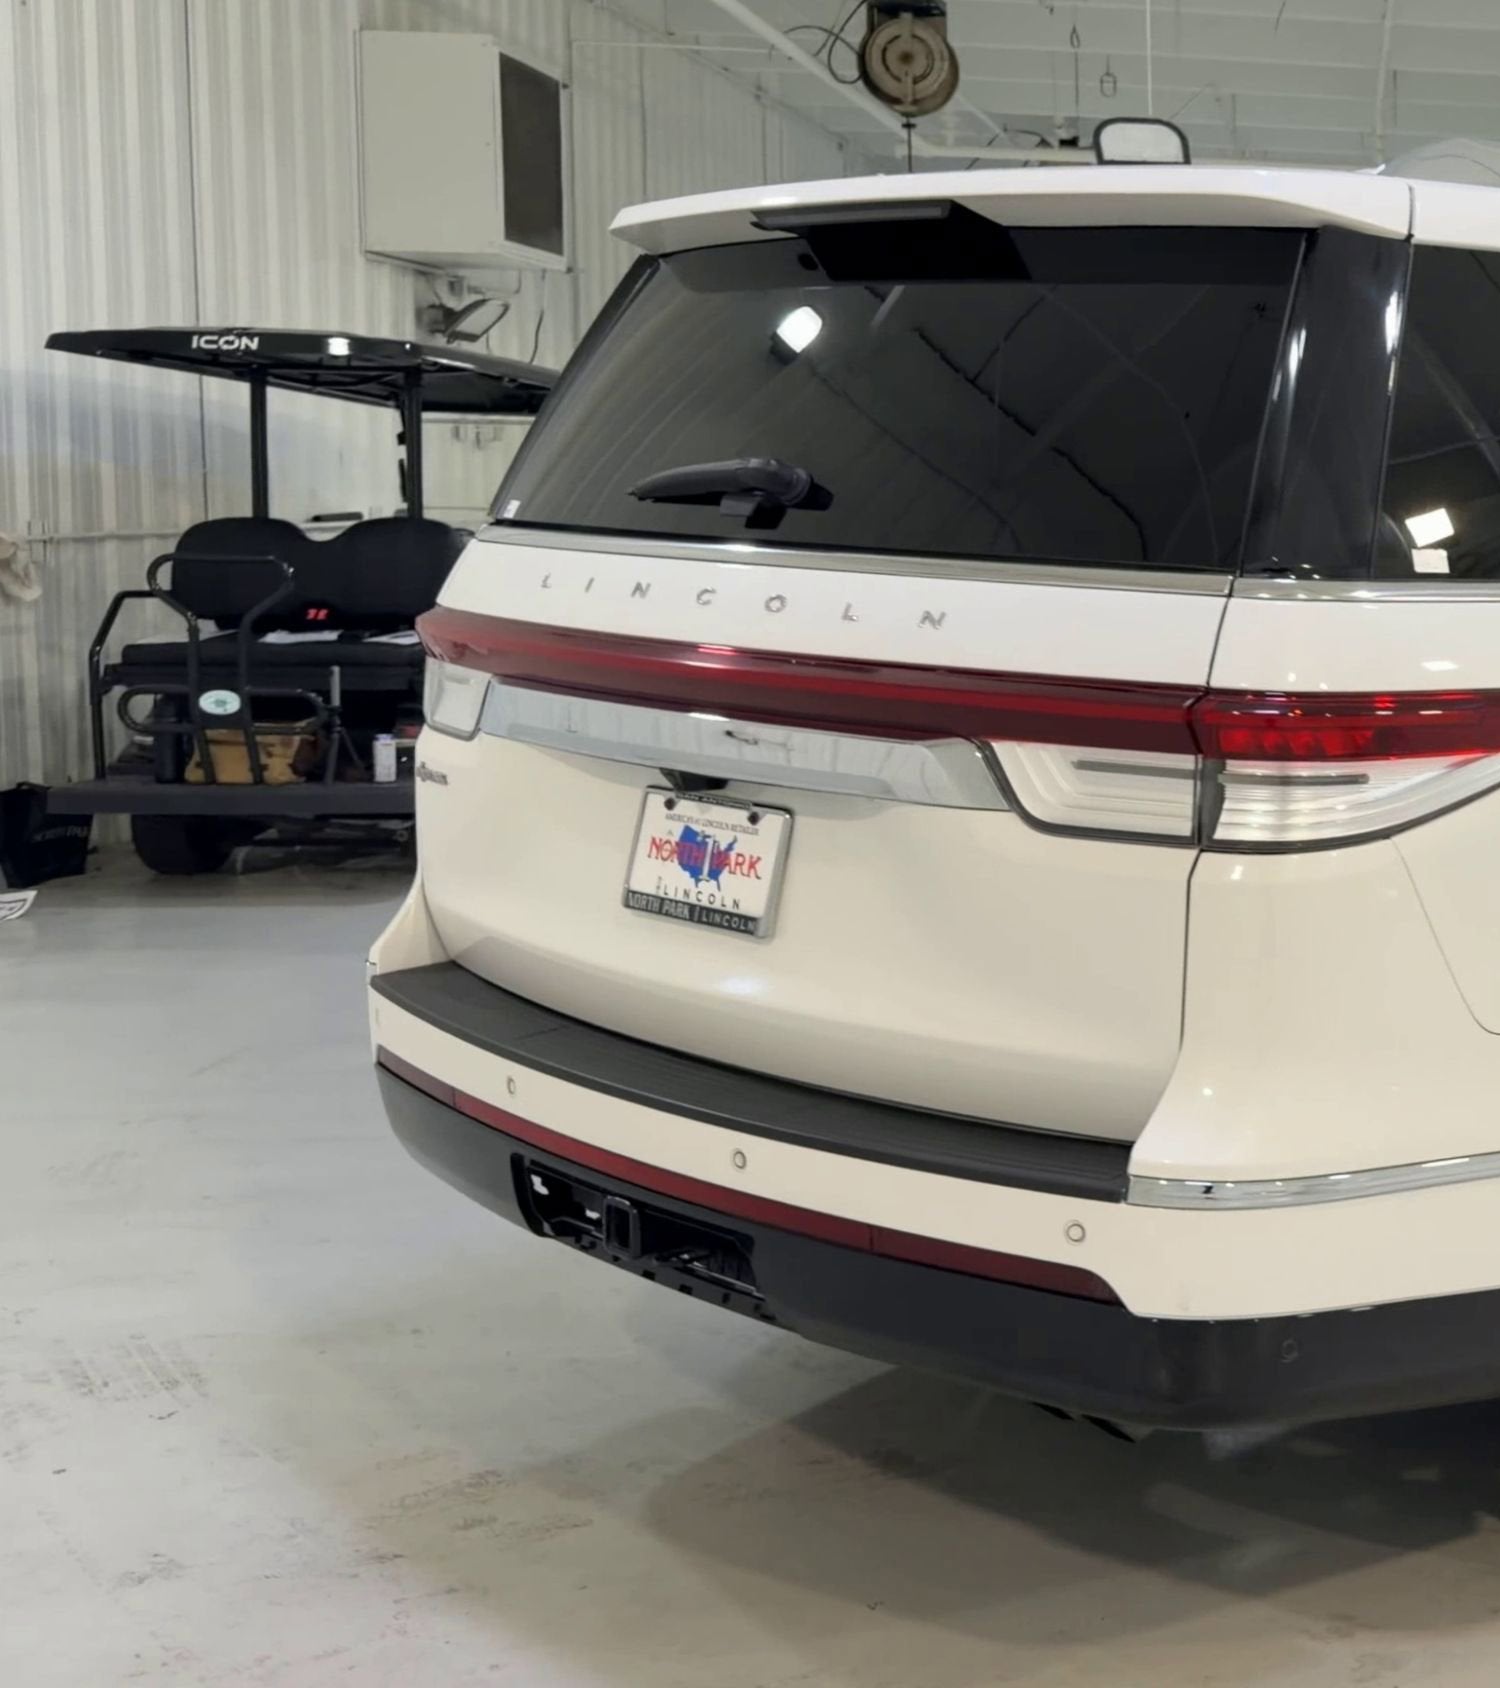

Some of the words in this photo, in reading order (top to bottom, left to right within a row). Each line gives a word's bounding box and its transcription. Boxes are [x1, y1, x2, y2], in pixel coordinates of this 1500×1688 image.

[191, 335, 259, 350] ICON
[541, 572, 946, 629] LINCOLN
[628, 892, 660, 911] NORTH
[662, 898, 690, 919] PARK
[701, 911, 755, 931] LINCOLN
[664, 884, 740, 909] LINCOLN
